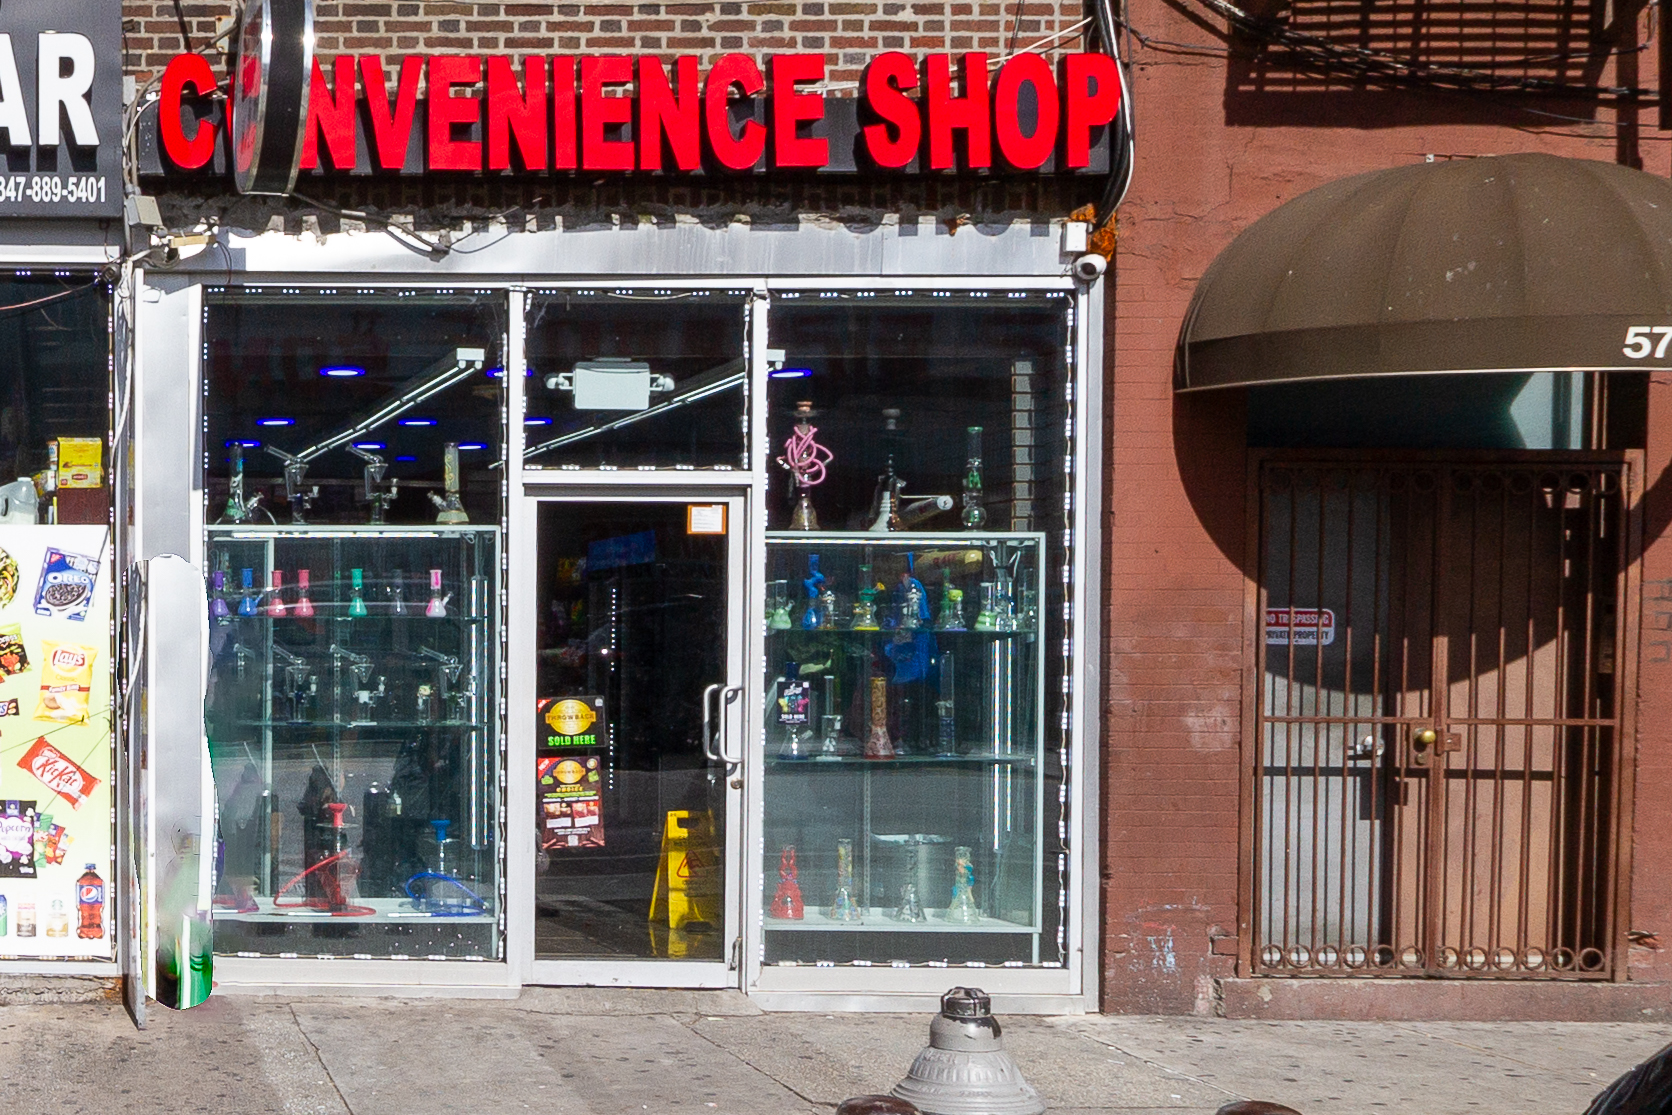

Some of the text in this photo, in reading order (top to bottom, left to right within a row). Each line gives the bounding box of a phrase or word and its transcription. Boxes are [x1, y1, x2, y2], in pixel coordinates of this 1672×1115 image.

[157, 51, 830, 171] CNVENIENCE
[864, 50, 1121, 170] SHOP
[1622, 326, 1672, 359] 57
[547, 734, 597, 747] SOLD HERE
